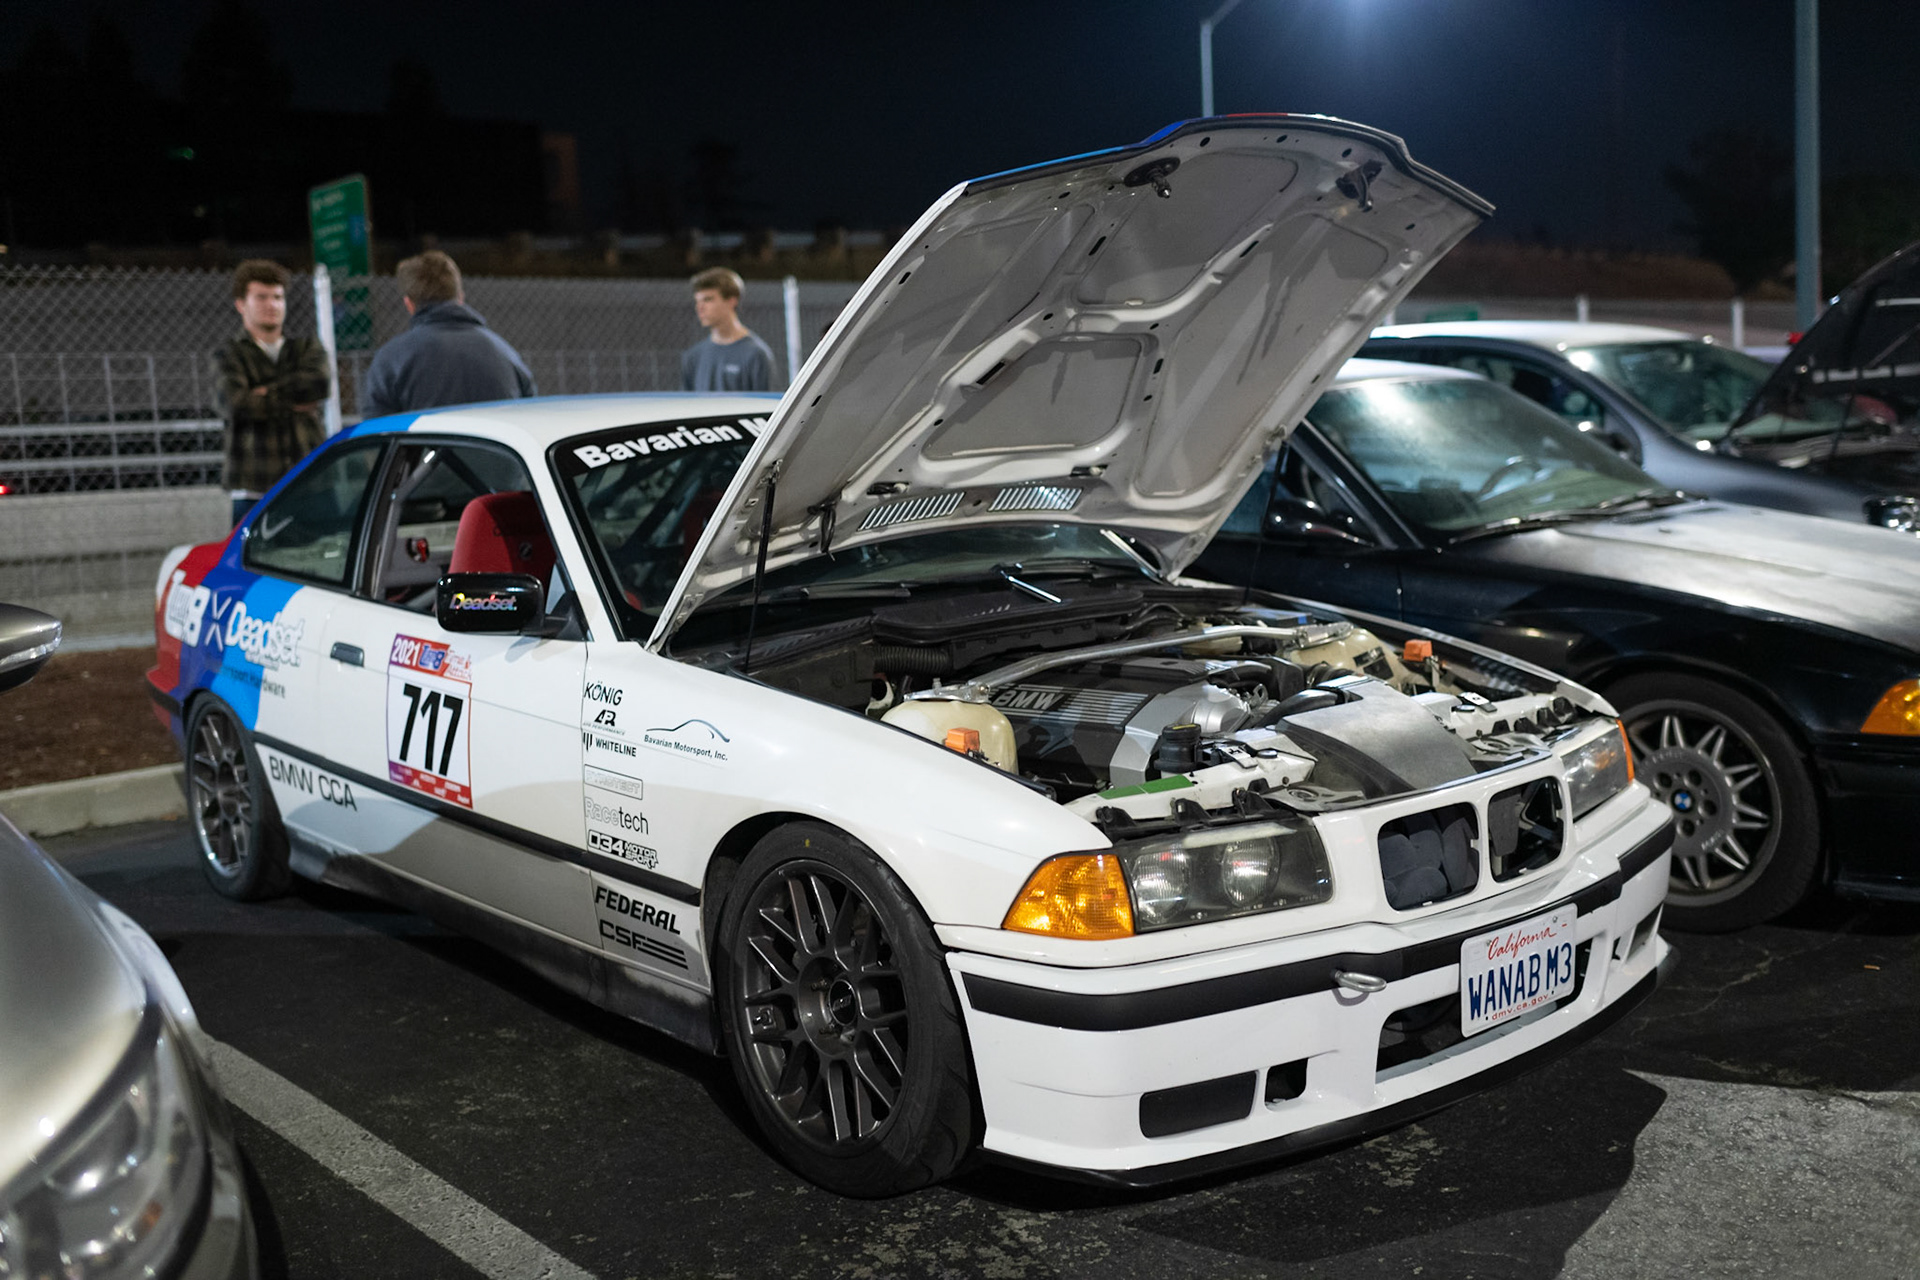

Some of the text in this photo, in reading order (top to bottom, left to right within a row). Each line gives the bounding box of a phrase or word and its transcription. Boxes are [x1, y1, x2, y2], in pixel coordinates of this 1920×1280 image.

[573, 426, 742, 468] Bavarian
[391, 637, 421, 667] 2021
[584, 681, 623, 706] KÖNIG
[992, 690, 1064, 710] BMW
[400, 683, 463, 776] 717
[595, 737, 637, 757] WHITELINE
[644, 734, 728, 761] Bavarian Motorsport, Inc.
[269, 756, 358, 811] BMW CCA
[585, 796, 649, 834] Racetech
[589, 831, 657, 859] 034 MOTOR
[595, 885, 681, 935] FEDERAL
[1488, 927, 1557, 960] California
[1468, 942, 1572, 1020] WANAB M3
[1492, 994, 1549, 1020] dmv.ca.gov
